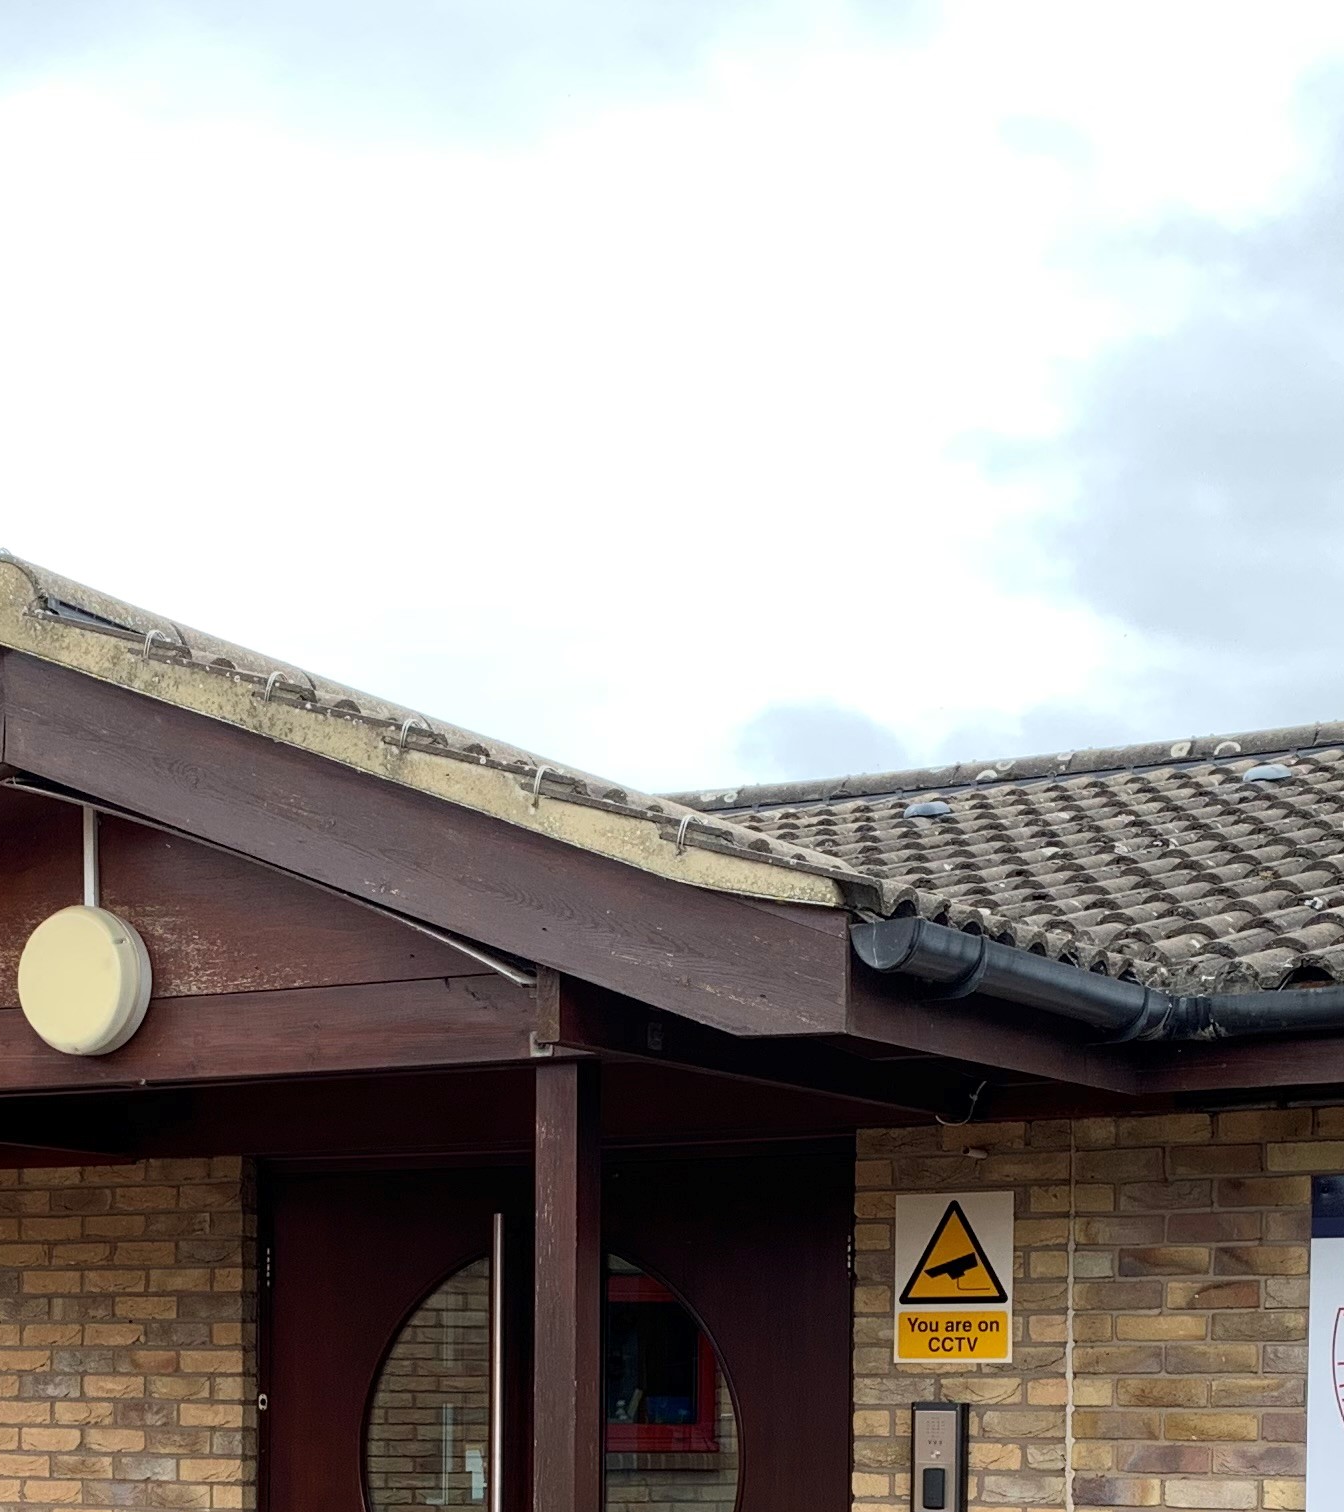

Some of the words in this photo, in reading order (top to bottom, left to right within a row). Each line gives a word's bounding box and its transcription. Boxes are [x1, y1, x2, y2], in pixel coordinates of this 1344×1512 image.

[907, 1317, 939, 1333] You
[944, 1320, 972, 1333] are
[977, 1320, 1000, 1333] on
[928, 1336, 979, 1352] CCTV
